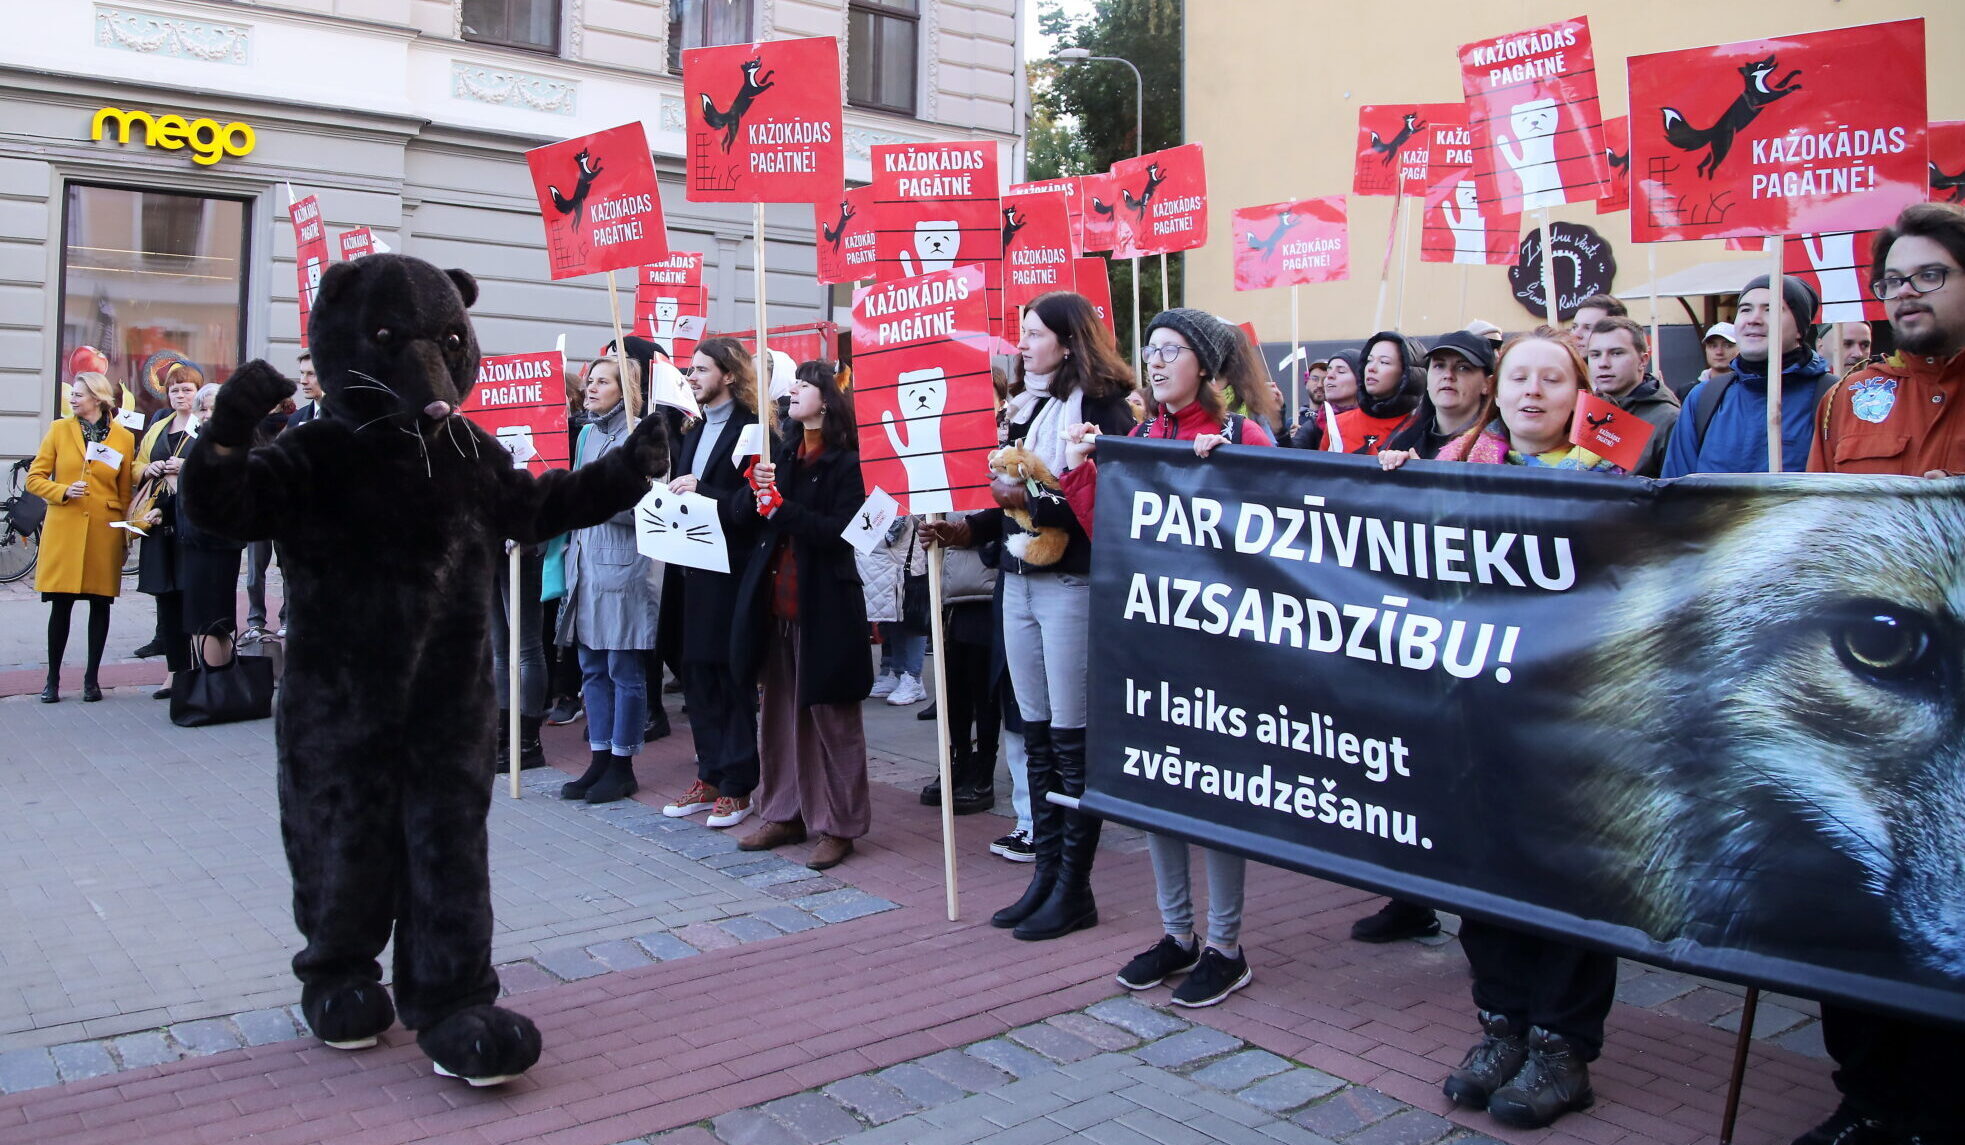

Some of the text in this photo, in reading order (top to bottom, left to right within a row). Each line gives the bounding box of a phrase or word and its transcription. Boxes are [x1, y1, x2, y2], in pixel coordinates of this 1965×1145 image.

[1473, 27, 1576, 67] KAŽOKĀDAS
[1490, 51, 1567, 87] PAGĀTNĒ
[91, 107, 256, 165] mego
[748, 117, 832, 145] KAŽOKĀDAS
[1752, 124, 1906, 165] KAŽOKĀDAS
[749, 146, 816, 174] PAGĀTNĒ!
[885, 147, 984, 172] KAŽOKĀDAS
[899, 173, 972, 197] PAGĀTNĒ
[1752, 160, 1875, 200] PAGĀTNĒ!
[590, 193, 653, 223] KAŽOKĀDAS
[1152, 195, 1201, 219] KAŽOKĀDAS
[593, 217, 643, 248] PAGĀTNĒ!
[1153, 214, 1193, 236] PAGĀTNĒ!
[844, 230, 876, 249] KAŽOKĀD
[1282, 238, 1341, 257] KAŽOKĀDAS
[846, 245, 876, 265] PAGĀTNĒ
[1011, 245, 1066, 266] KAŽOKĀDAS
[1282, 254, 1331, 272] PAGĀTNĒ!
[649, 269, 687, 284] PAGĀTNĒ
[1012, 266, 1057, 285] PAGĀTNĒ!
[864, 276, 969, 318] KAŽOKĀDAS
[879, 306, 957, 346] PAGĀTNĒ
[475, 359, 552, 384] AŽOKĀDAS
[481, 381, 543, 406] PAGĀTNĒ
[1129, 489, 1576, 592] PAR DZĪVNIEKU
[1123, 572, 1521, 684] AIZSARDZĪBU!
[1125, 678, 1411, 783] Ir laiks aizliegt
[1122, 744, 1434, 850] zvēraudzēšanu.
